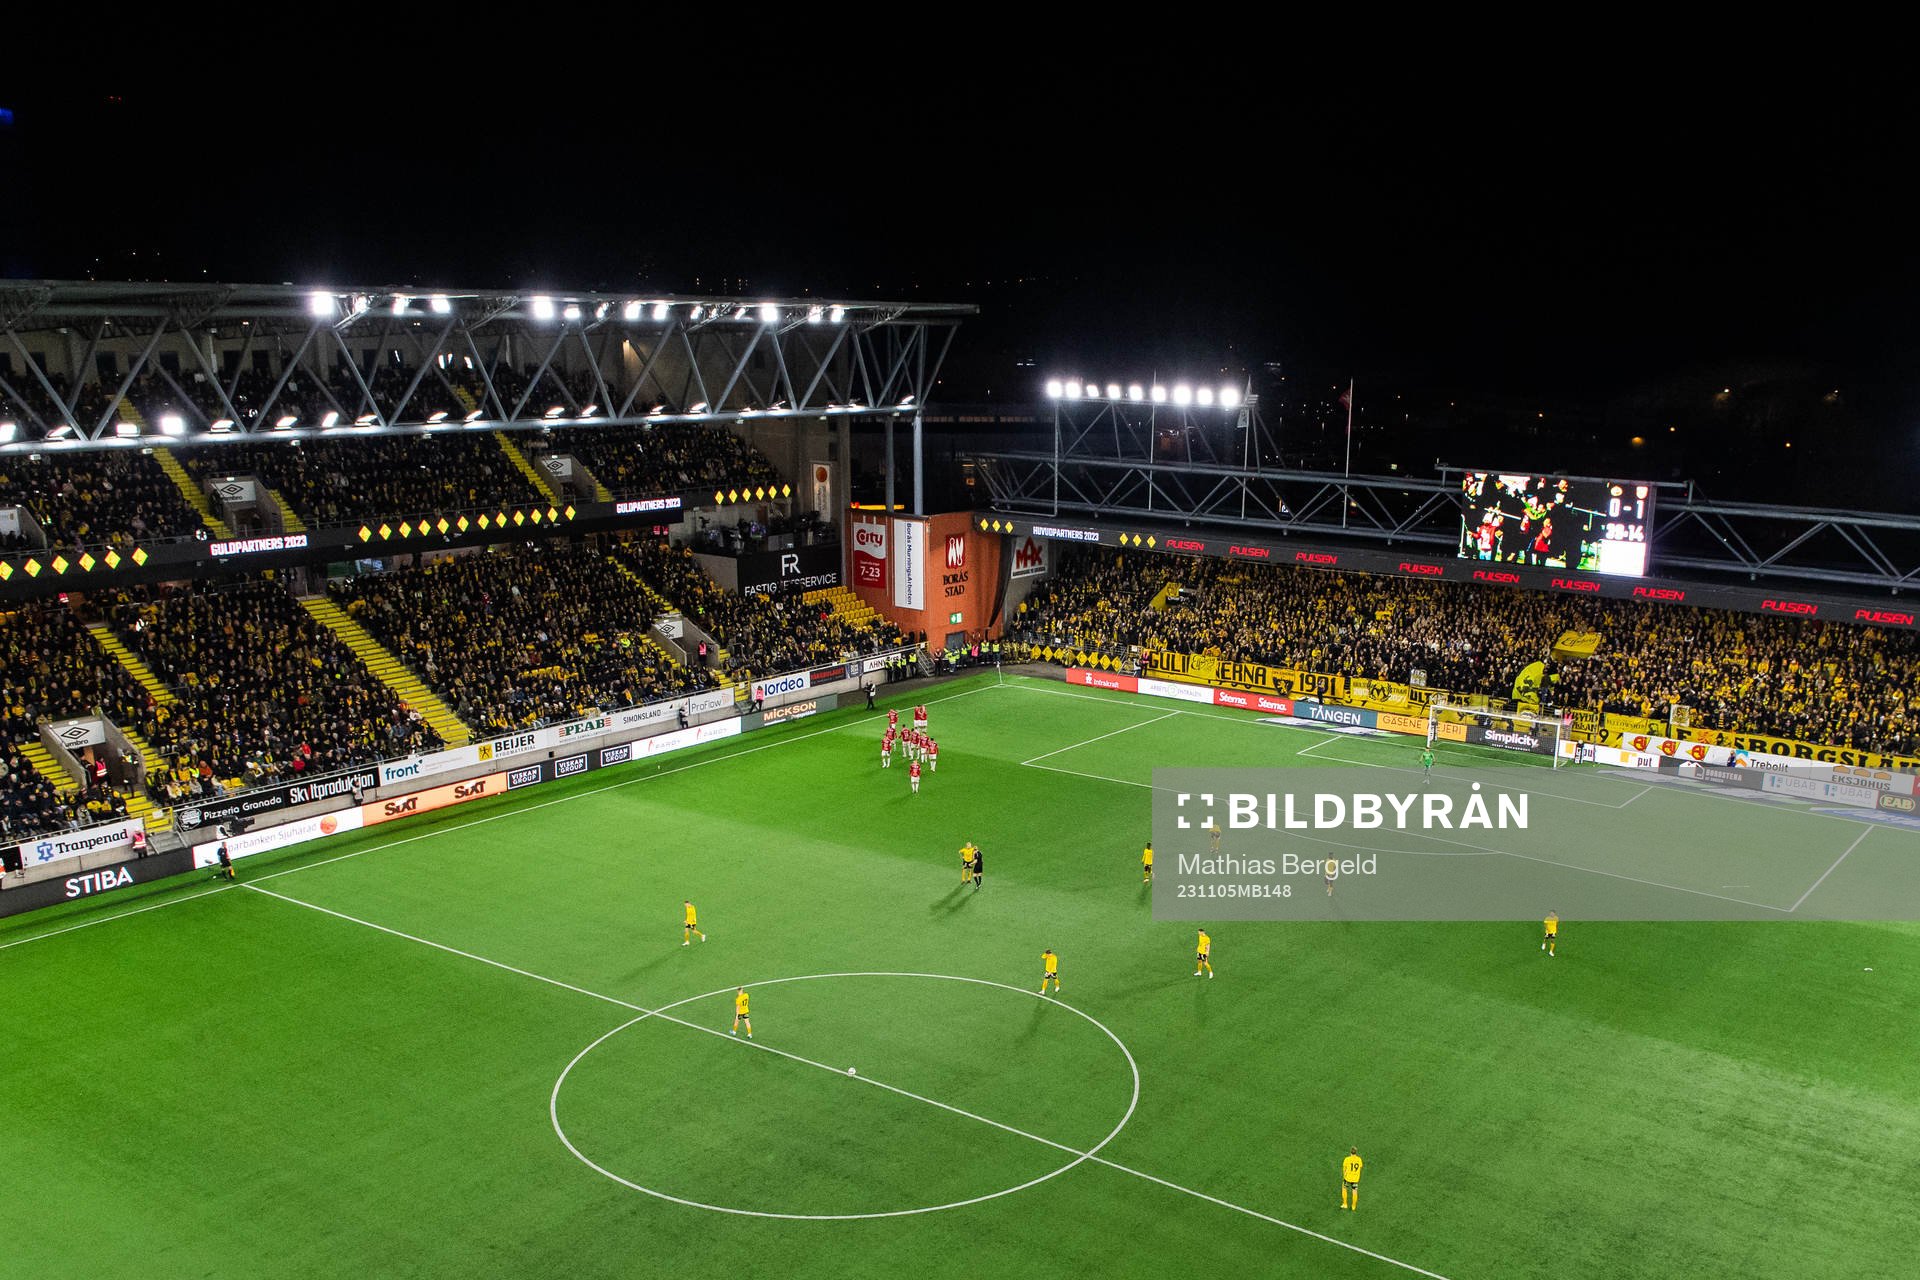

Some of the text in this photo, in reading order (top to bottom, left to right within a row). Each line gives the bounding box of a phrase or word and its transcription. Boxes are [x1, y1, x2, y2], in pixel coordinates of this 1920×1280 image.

[616, 497, 681, 514] GULDPARTNERS 2023
[1032, 526, 1099, 541] HUVUDPARTNERS 2023
[210, 534, 308, 556] GULDPARTNERS 2023
[1166, 539, 1204, 551] PULSEN
[1229, 546, 1270, 558] PULSEN
[1295, 552, 1338, 565] PULSEN
[860, 566, 880, 578] 7-23
[1399, 563, 1444, 576] PULSEN
[943, 571, 968, 586] BORÅS
[1472, 571, 1520, 583] PULSEN
[945, 586, 964, 598] STAD
[1551, 579, 1600, 592] PULSEN
[1633, 587, 1685, 601] PULSEN
[1761, 600, 1818, 615] PULSEN
[1855, 609, 1914, 625] PULSEN
[623, 709, 662, 724] SIMONSLAND
[564, 718, 605, 736] PEAB
[494, 734, 535, 753] BEIJER
[1484, 729, 1538, 749] Simplicity
[604, 746, 628, 757] VISKAN
[606, 752, 628, 763] GROUP
[559, 758, 584, 769] VISKAN
[560, 764, 583, 773] GROUP
[1750, 759, 1788, 773] Trebolit
[385, 762, 419, 780] front
[511, 769, 537, 780] VISKAN
[513, 775, 537, 785] GROUP
[1785, 779, 1816, 790] UBAB
[1840, 787, 1872, 799] UBAB
[203, 806, 240, 820] Pizzeria
[242, 796, 283, 811] Granada
[1884, 796, 1912, 810] EAB
[56, 829, 128, 855] Tranpenad
[65, 866, 134, 898] STIBA
[1350, 1163, 1360, 1172] 19
